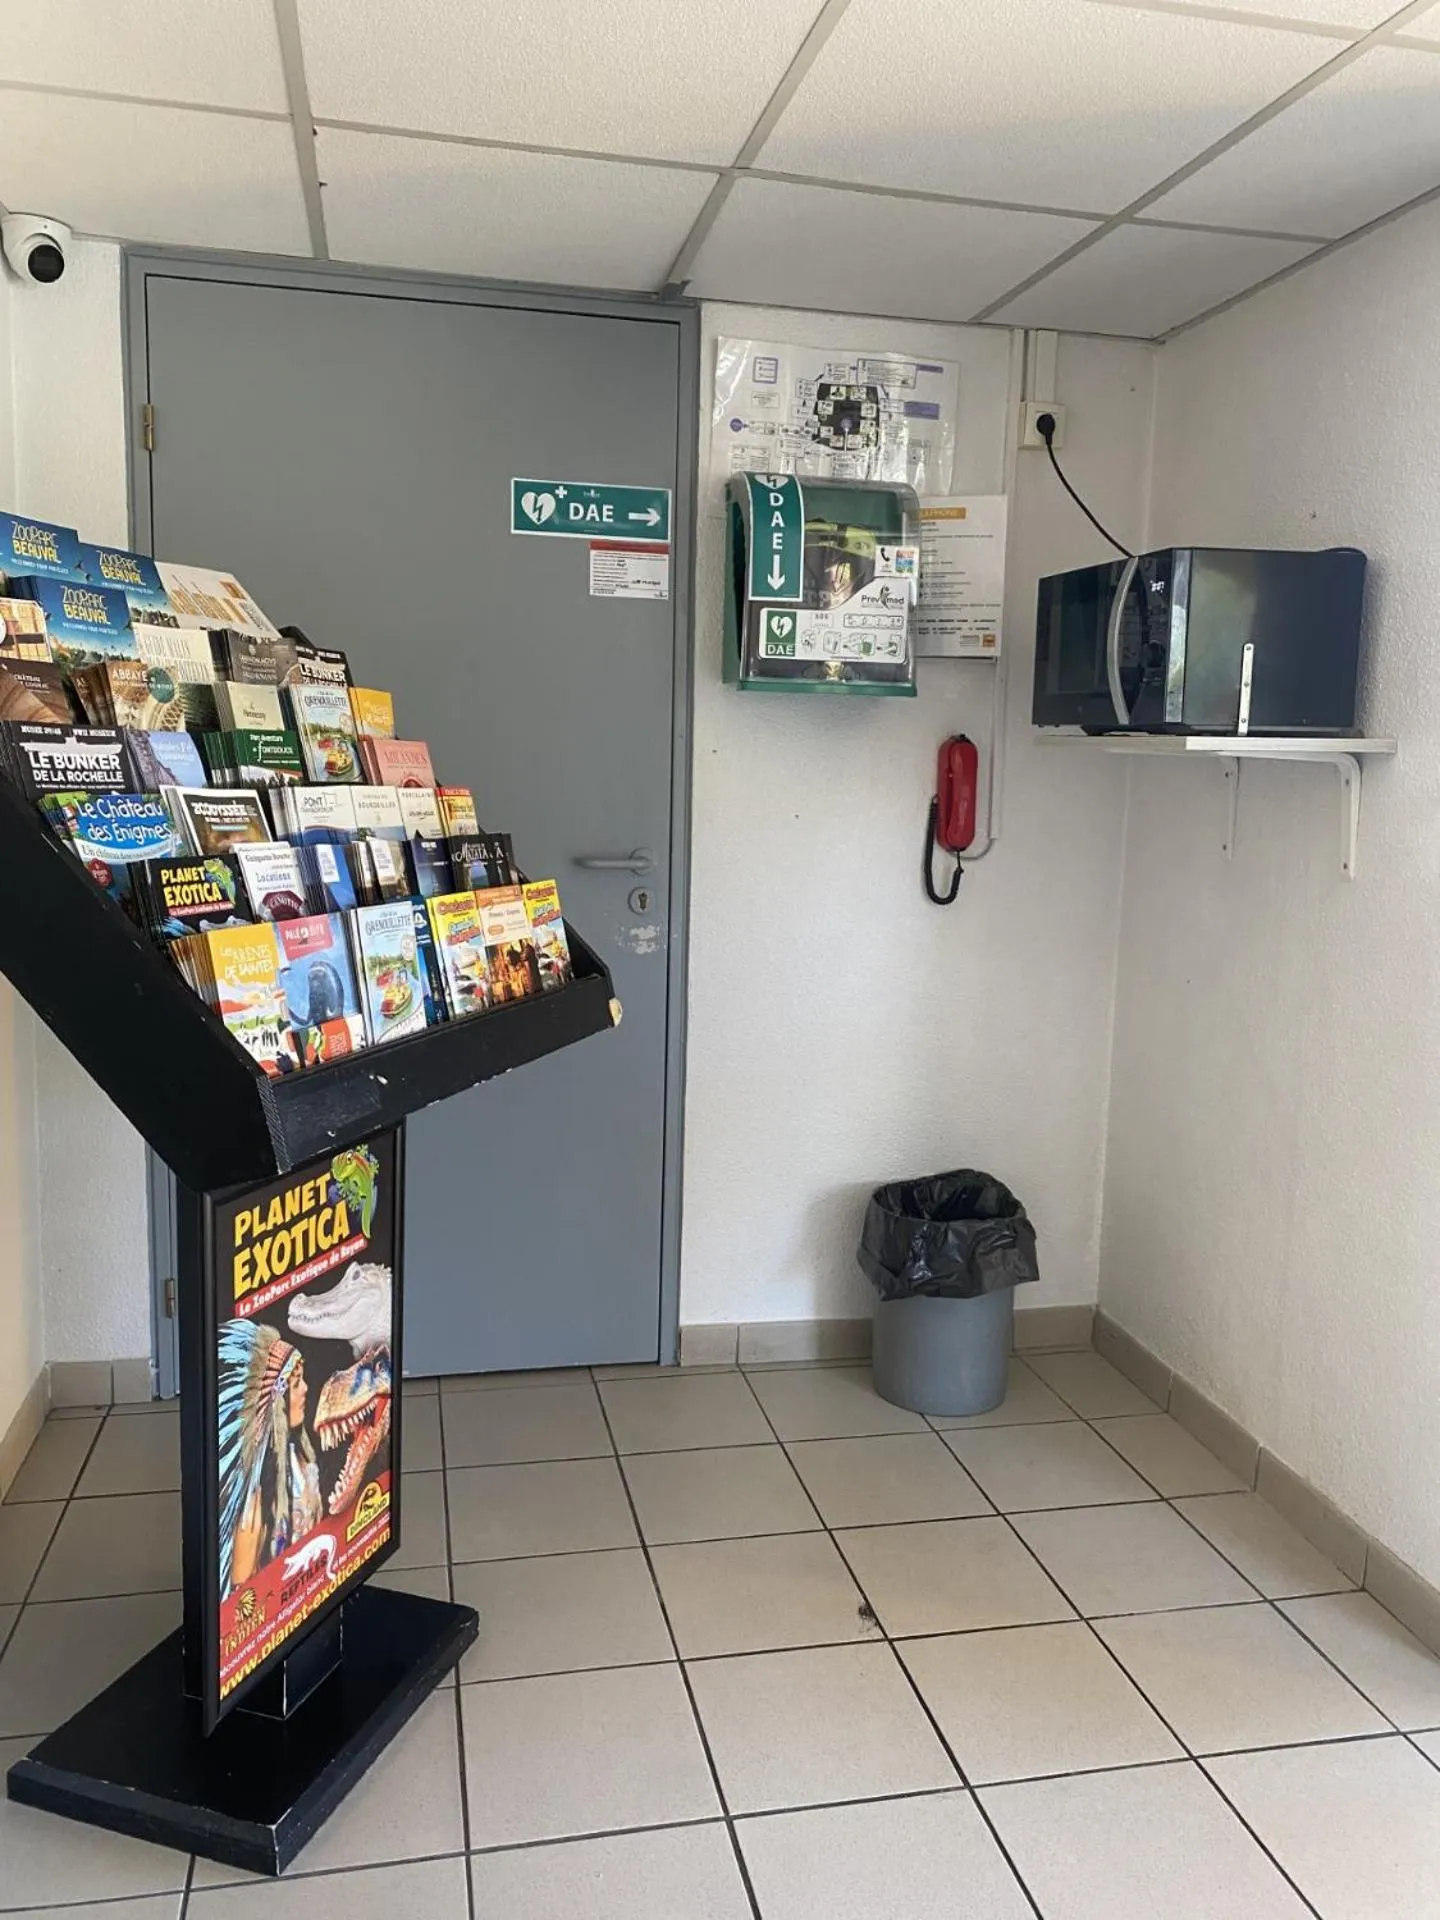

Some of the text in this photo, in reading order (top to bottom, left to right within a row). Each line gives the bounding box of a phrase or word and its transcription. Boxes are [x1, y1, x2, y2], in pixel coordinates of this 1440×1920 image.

[569, 502, 614, 523] DAE
[769, 492, 785, 549] DAE
[13, 540, 62, 563] BEAUVAL
[101, 566, 146, 586] BEAUVAL
[63, 604, 111, 624] BEAUVAL
[767, 644, 794, 655] DAE
[112, 667, 149, 681] ABBAYE
[28, 751, 121, 770] LE BUNKER
[33, 770, 125, 783] DE LA ROCHELLE
[75, 799, 163, 819] Le Château
[88, 819, 172, 845] des Énigmes
[161, 867, 206, 884] PLANET
[163, 882, 222, 907] EXOTICA
[234, 1171, 331, 1247] PLANET
[233, 1199, 351, 1301] EXOTICA
[253, 1282, 290, 1306] ZooParc
[291, 1259, 329, 1287] Exotique
[330, 1251, 340, 1265] de
[220, 1527, 391, 1701] www.planet-exotica.com
